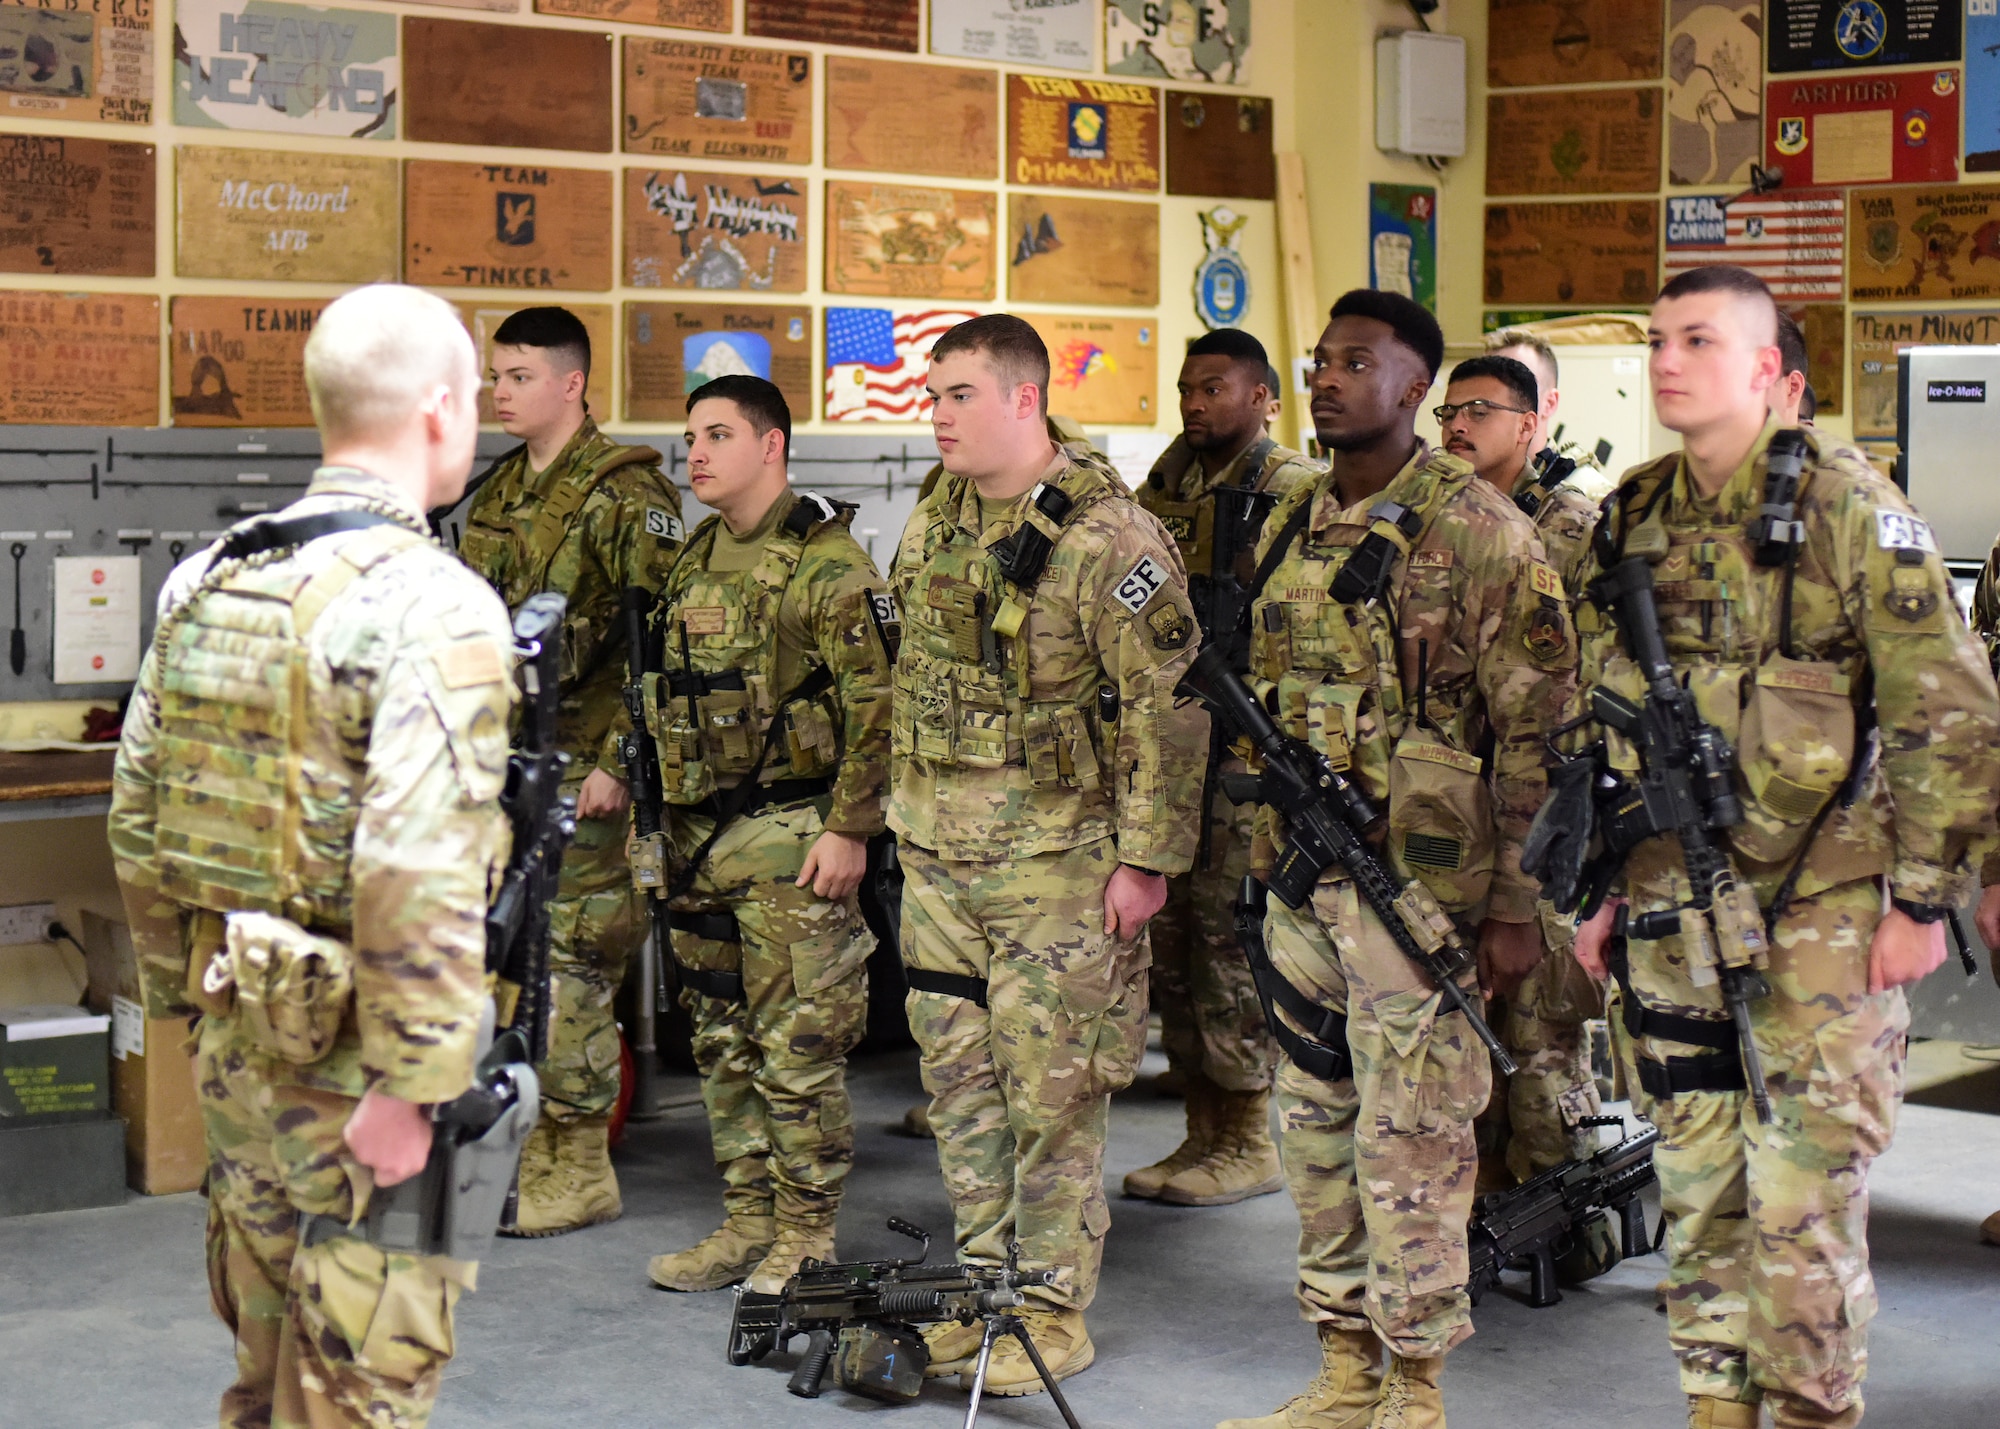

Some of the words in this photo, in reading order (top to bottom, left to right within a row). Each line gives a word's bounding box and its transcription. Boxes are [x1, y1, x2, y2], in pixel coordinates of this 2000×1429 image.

[219, 13, 357, 61] HEAVY
[651, 40, 722, 61] SECURITY
[701, 63, 740, 79] TEAM
[1020, 75, 1081, 99] TEAM
[1791, 80, 1900, 104] ARMORY
[652, 137, 692, 154] TEAM
[703, 140, 789, 160] ELLSWORTH
[483, 165, 549, 186] TEAM
[218, 180, 350, 213] McChord
[1670, 198, 1724, 221] TEAM
[263, 229, 310, 251] AFB
[1669, 222, 1725, 241] CANNON
[460, 266, 553, 288] TINKER
[0, 300, 54, 325] REN
[1856, 316, 1913, 341] TEAM
[1928, 385, 1984, 398] Ice-O-Matic
[649, 510, 680, 537] SF
[1882, 513, 1927, 547] SF
[1120, 559, 1160, 610] SF
[1536, 568, 1558, 593] SF
[1285, 588, 1326, 602] MARTIN
[883, 1352, 897, 1382] 1
